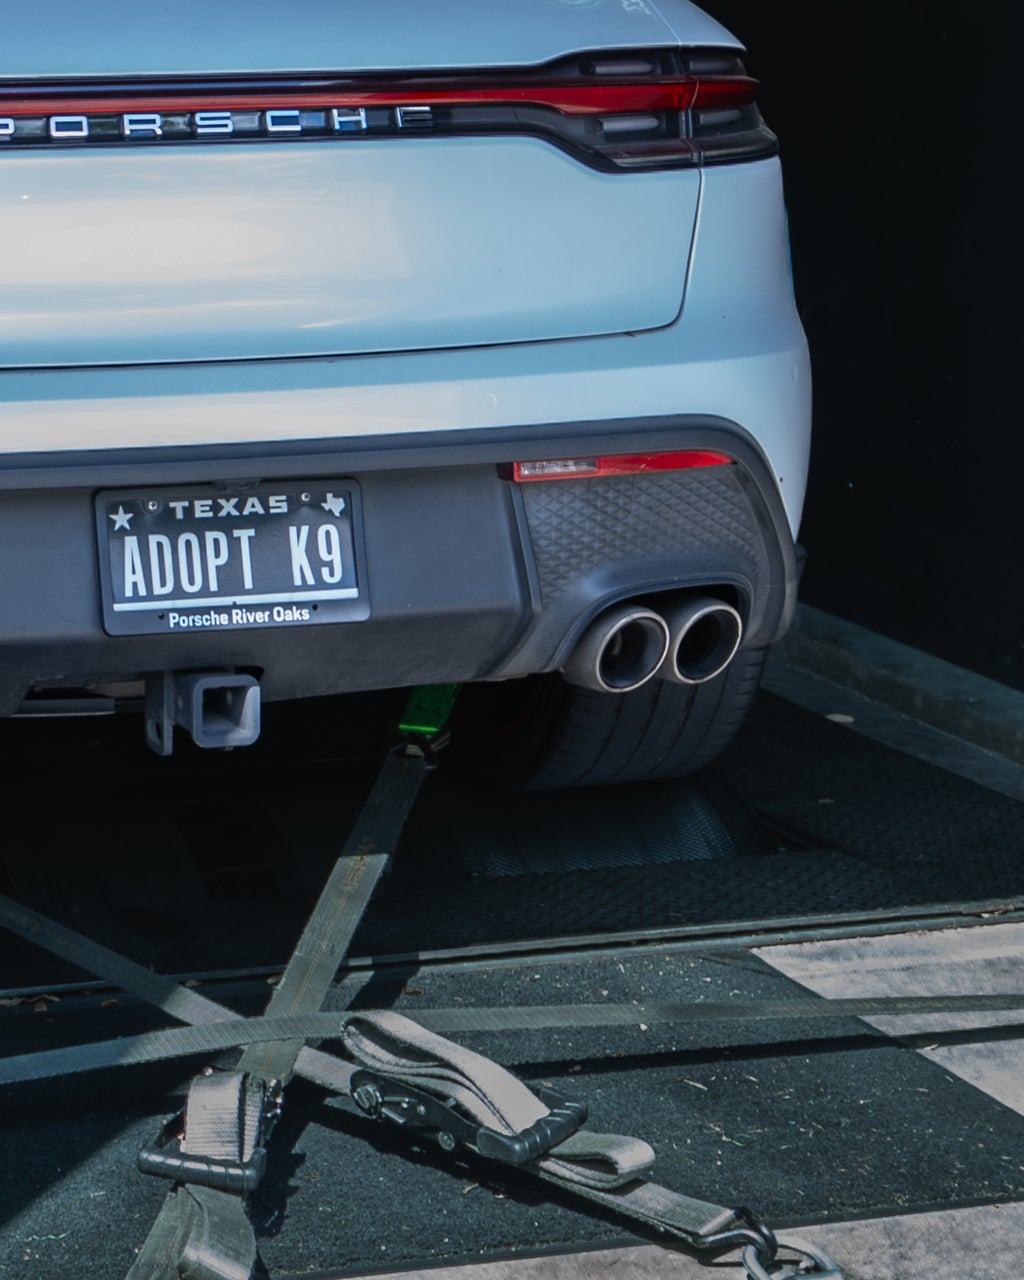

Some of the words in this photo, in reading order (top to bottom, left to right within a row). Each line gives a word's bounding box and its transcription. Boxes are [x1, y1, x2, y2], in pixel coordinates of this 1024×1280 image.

[168, 495, 288, 520] TEXAS
[123, 528, 256, 598] ADOPT
[288, 523, 343, 587] K9
[169, 611, 229, 628] Porsche
[232, 608, 271, 624] River
[273, 605, 310, 622] Oaks
